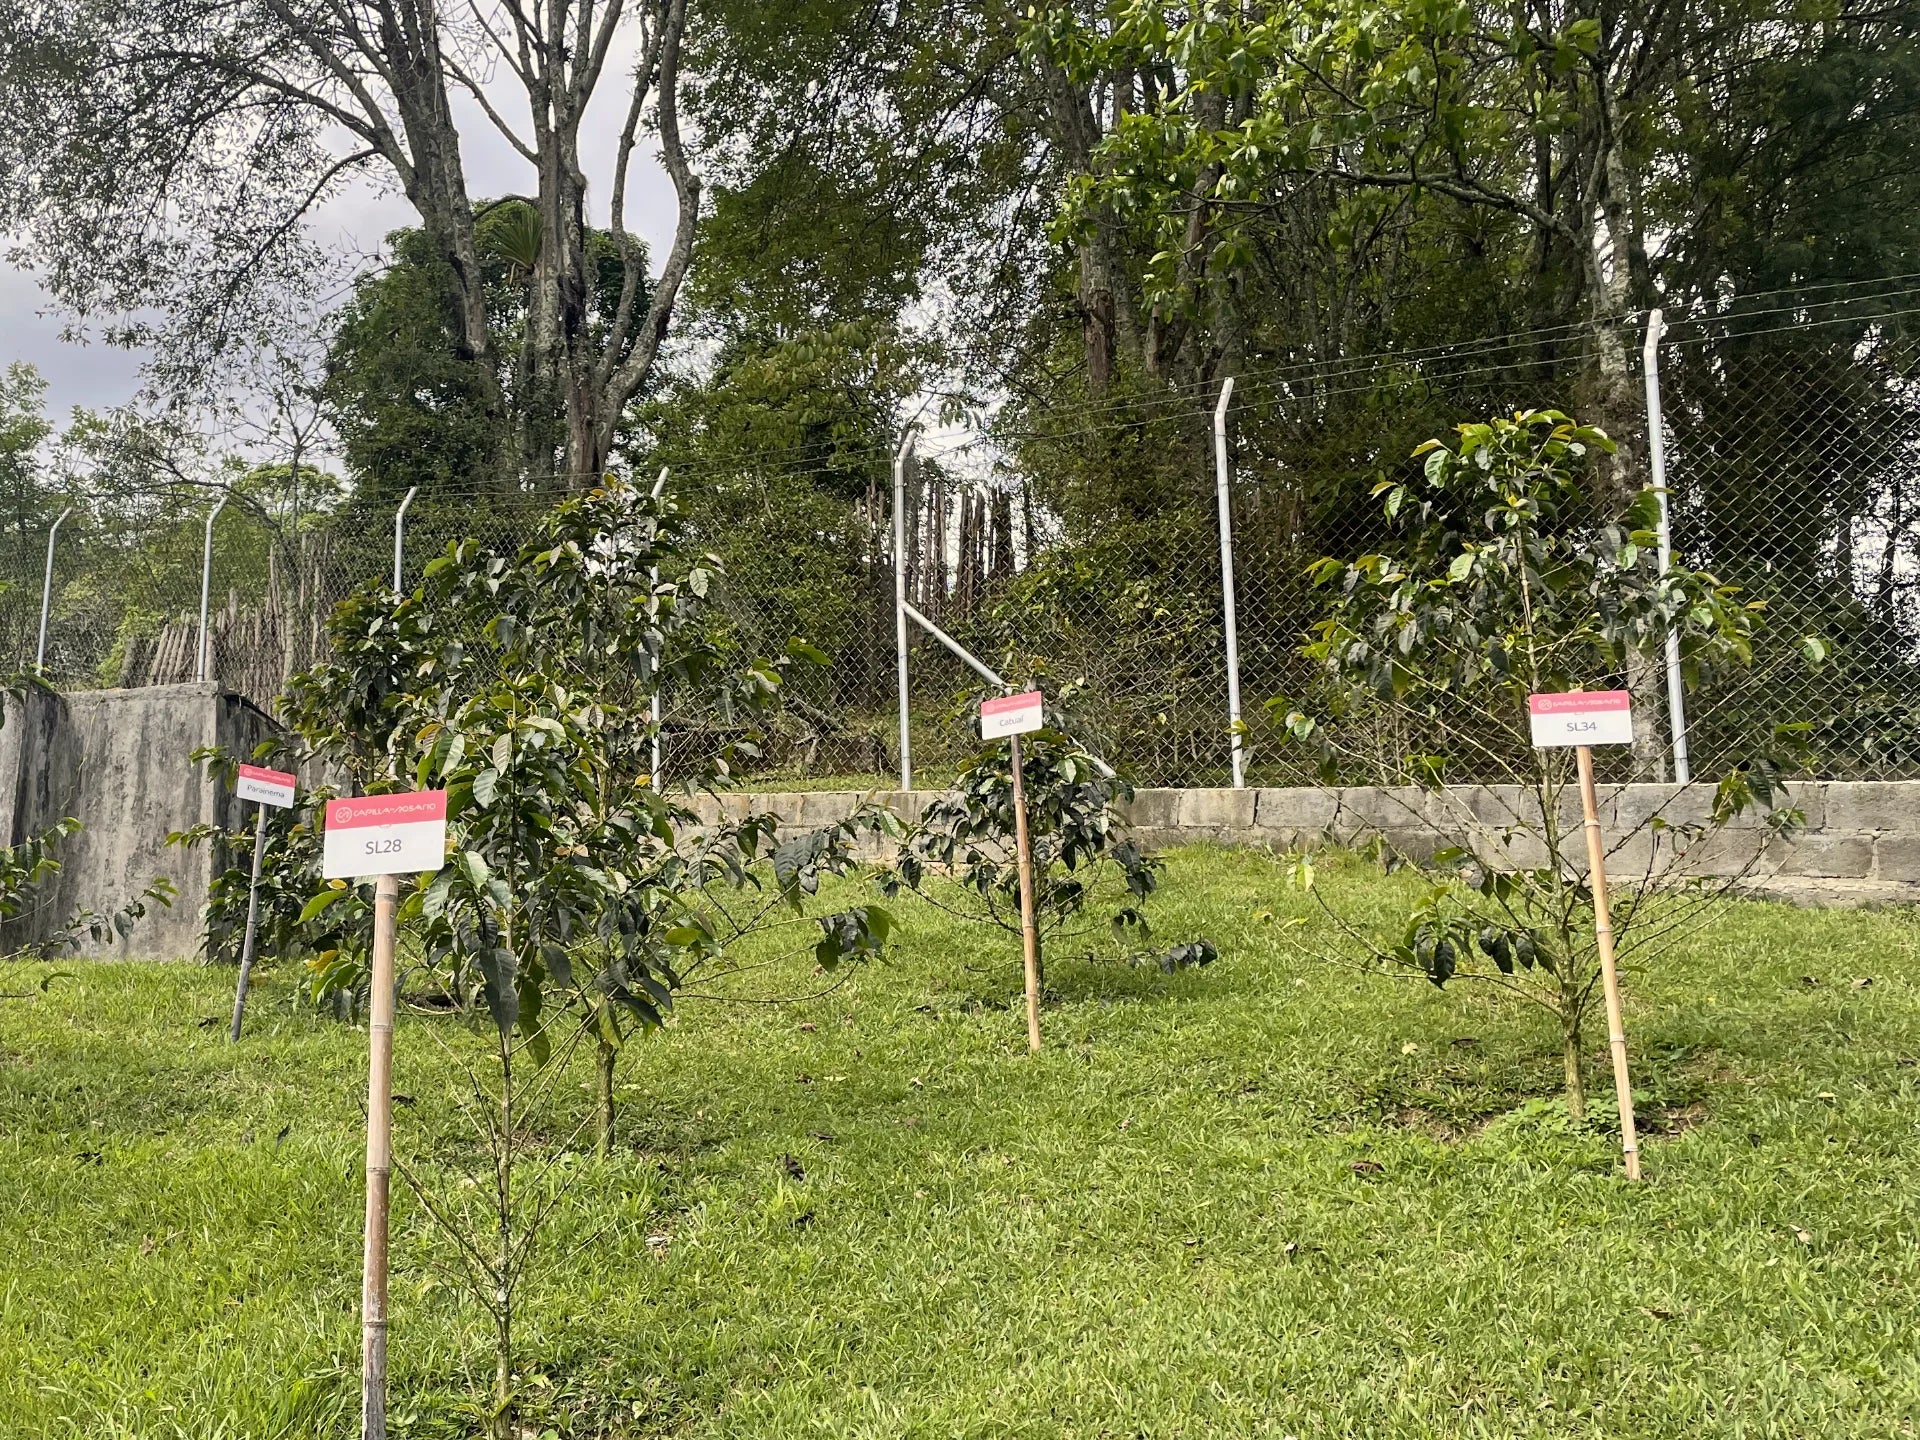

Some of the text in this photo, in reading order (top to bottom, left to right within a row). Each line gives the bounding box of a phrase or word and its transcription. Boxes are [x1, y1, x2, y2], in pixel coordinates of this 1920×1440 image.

[1566, 721, 1598, 732] SL34
[247, 784, 285, 798] Parainema
[353, 807, 391, 817] CAPILLA
[365, 839, 402, 855] SL28
